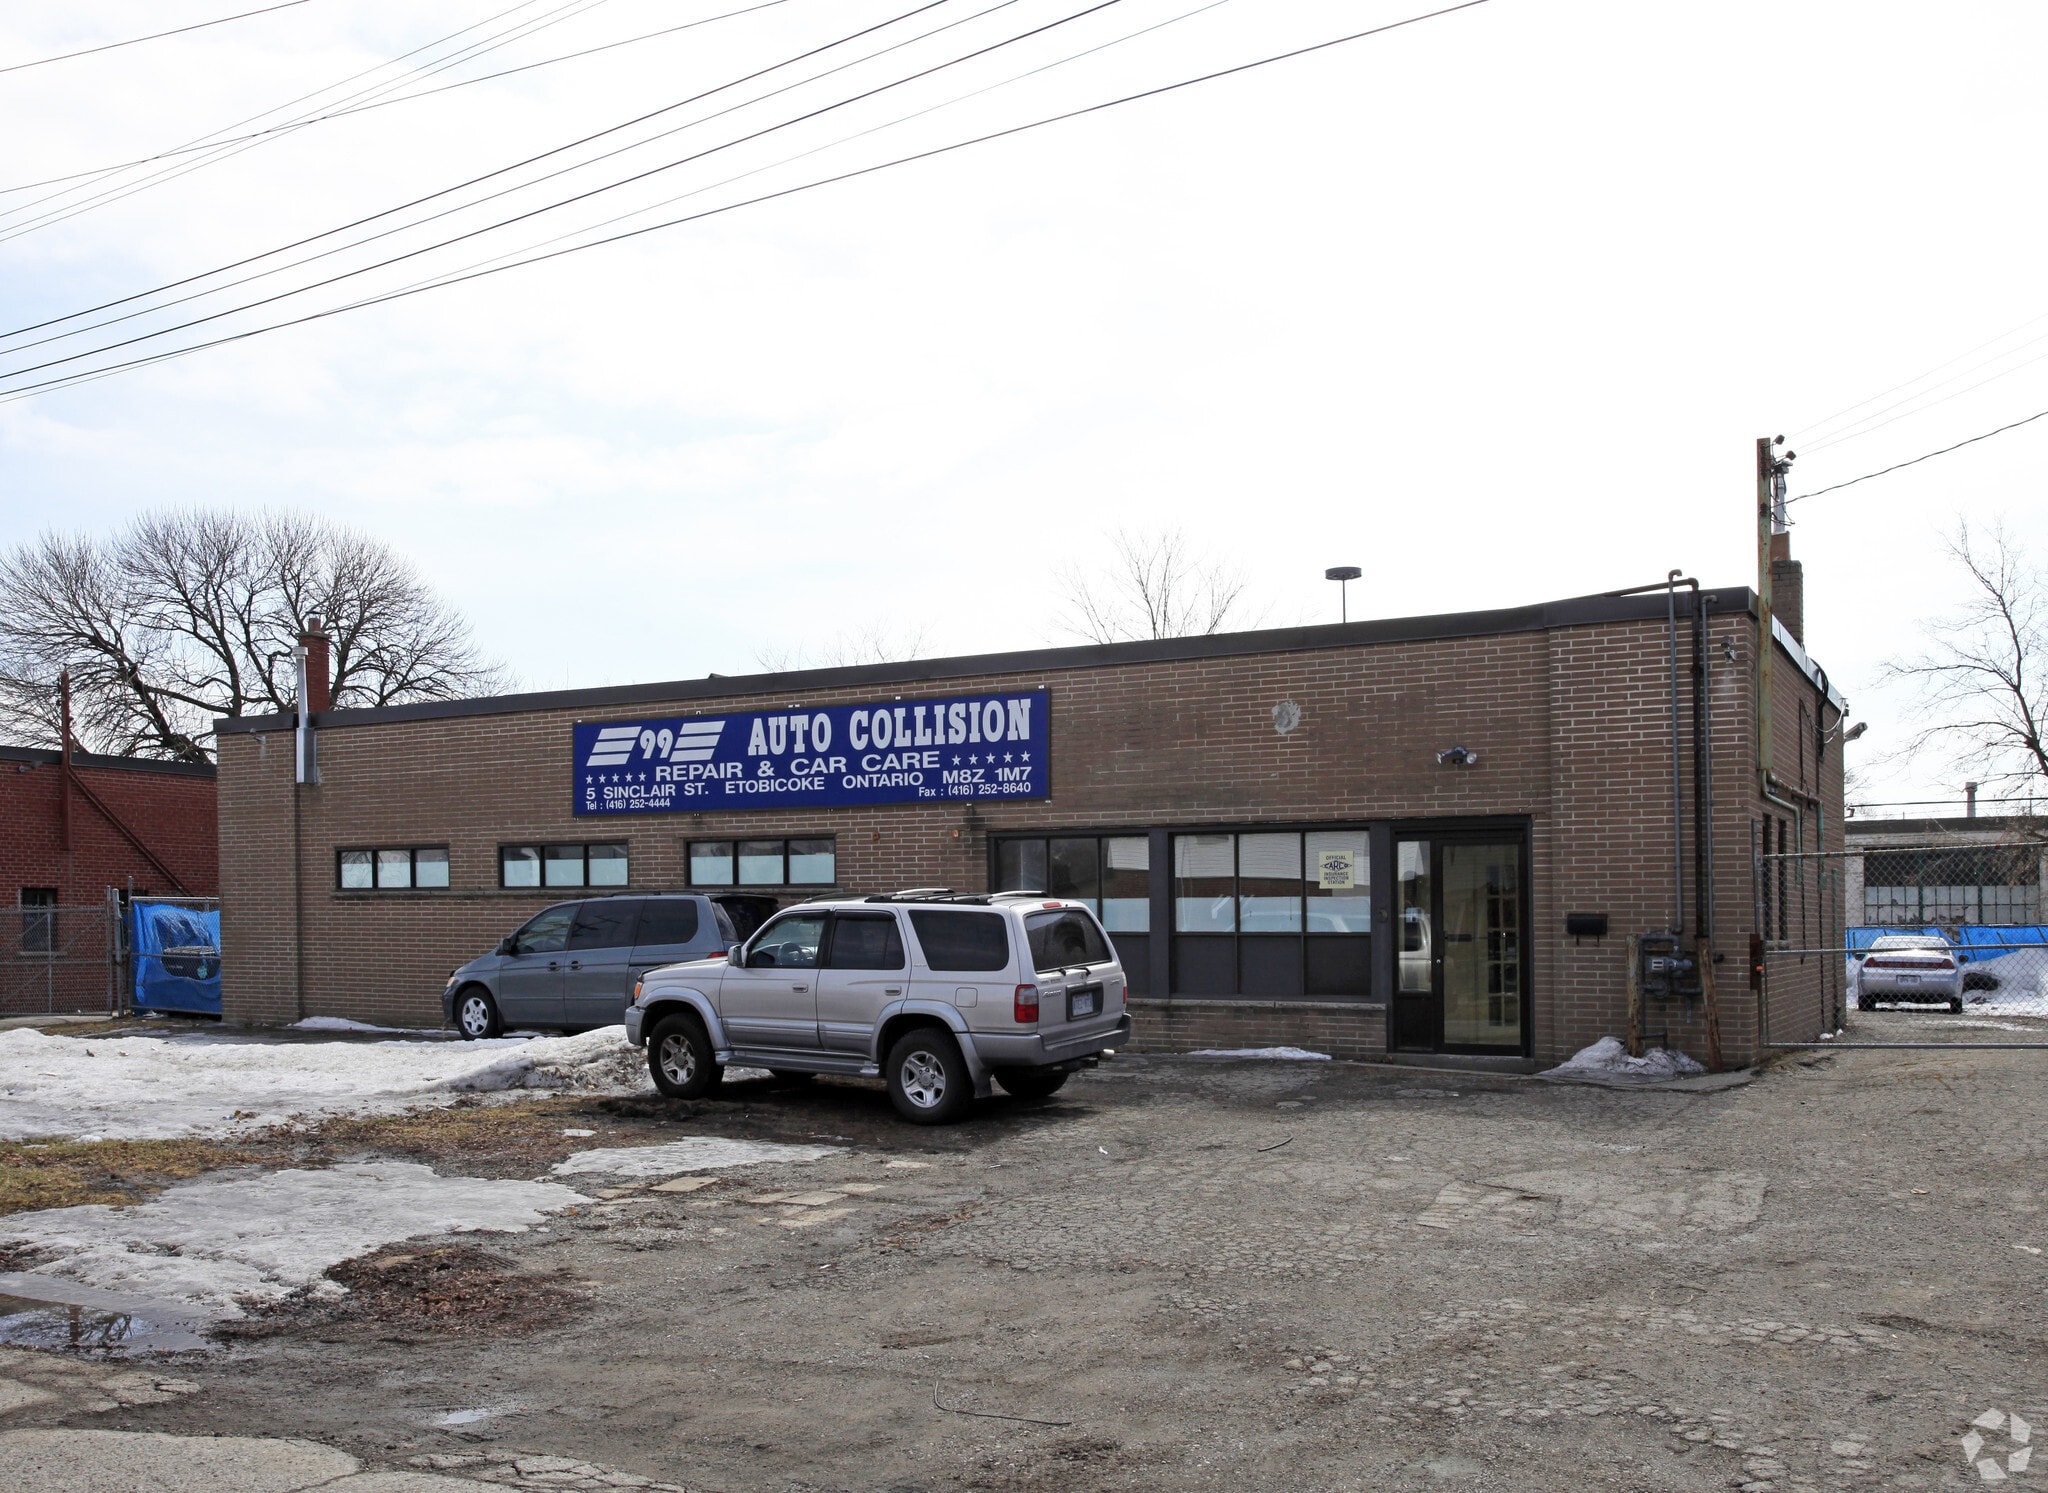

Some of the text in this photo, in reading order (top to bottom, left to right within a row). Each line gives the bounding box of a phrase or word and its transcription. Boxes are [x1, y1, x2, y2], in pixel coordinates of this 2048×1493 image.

[639, 698, 1032, 759] 99 AUTO COLLISION
[655, 750, 941, 782] REPAIR & CAR CARE
[586, 766, 1032, 800] 5 SINCLAIR ST. ETOBICOKE ONTARIO M8Z 1M7
[948, 784, 974, 797] (416)
[978, 782, 1031, 795] 252-8640
[605, 799, 627, 810] (416)
[629, 798, 671, 809] 252-4444
